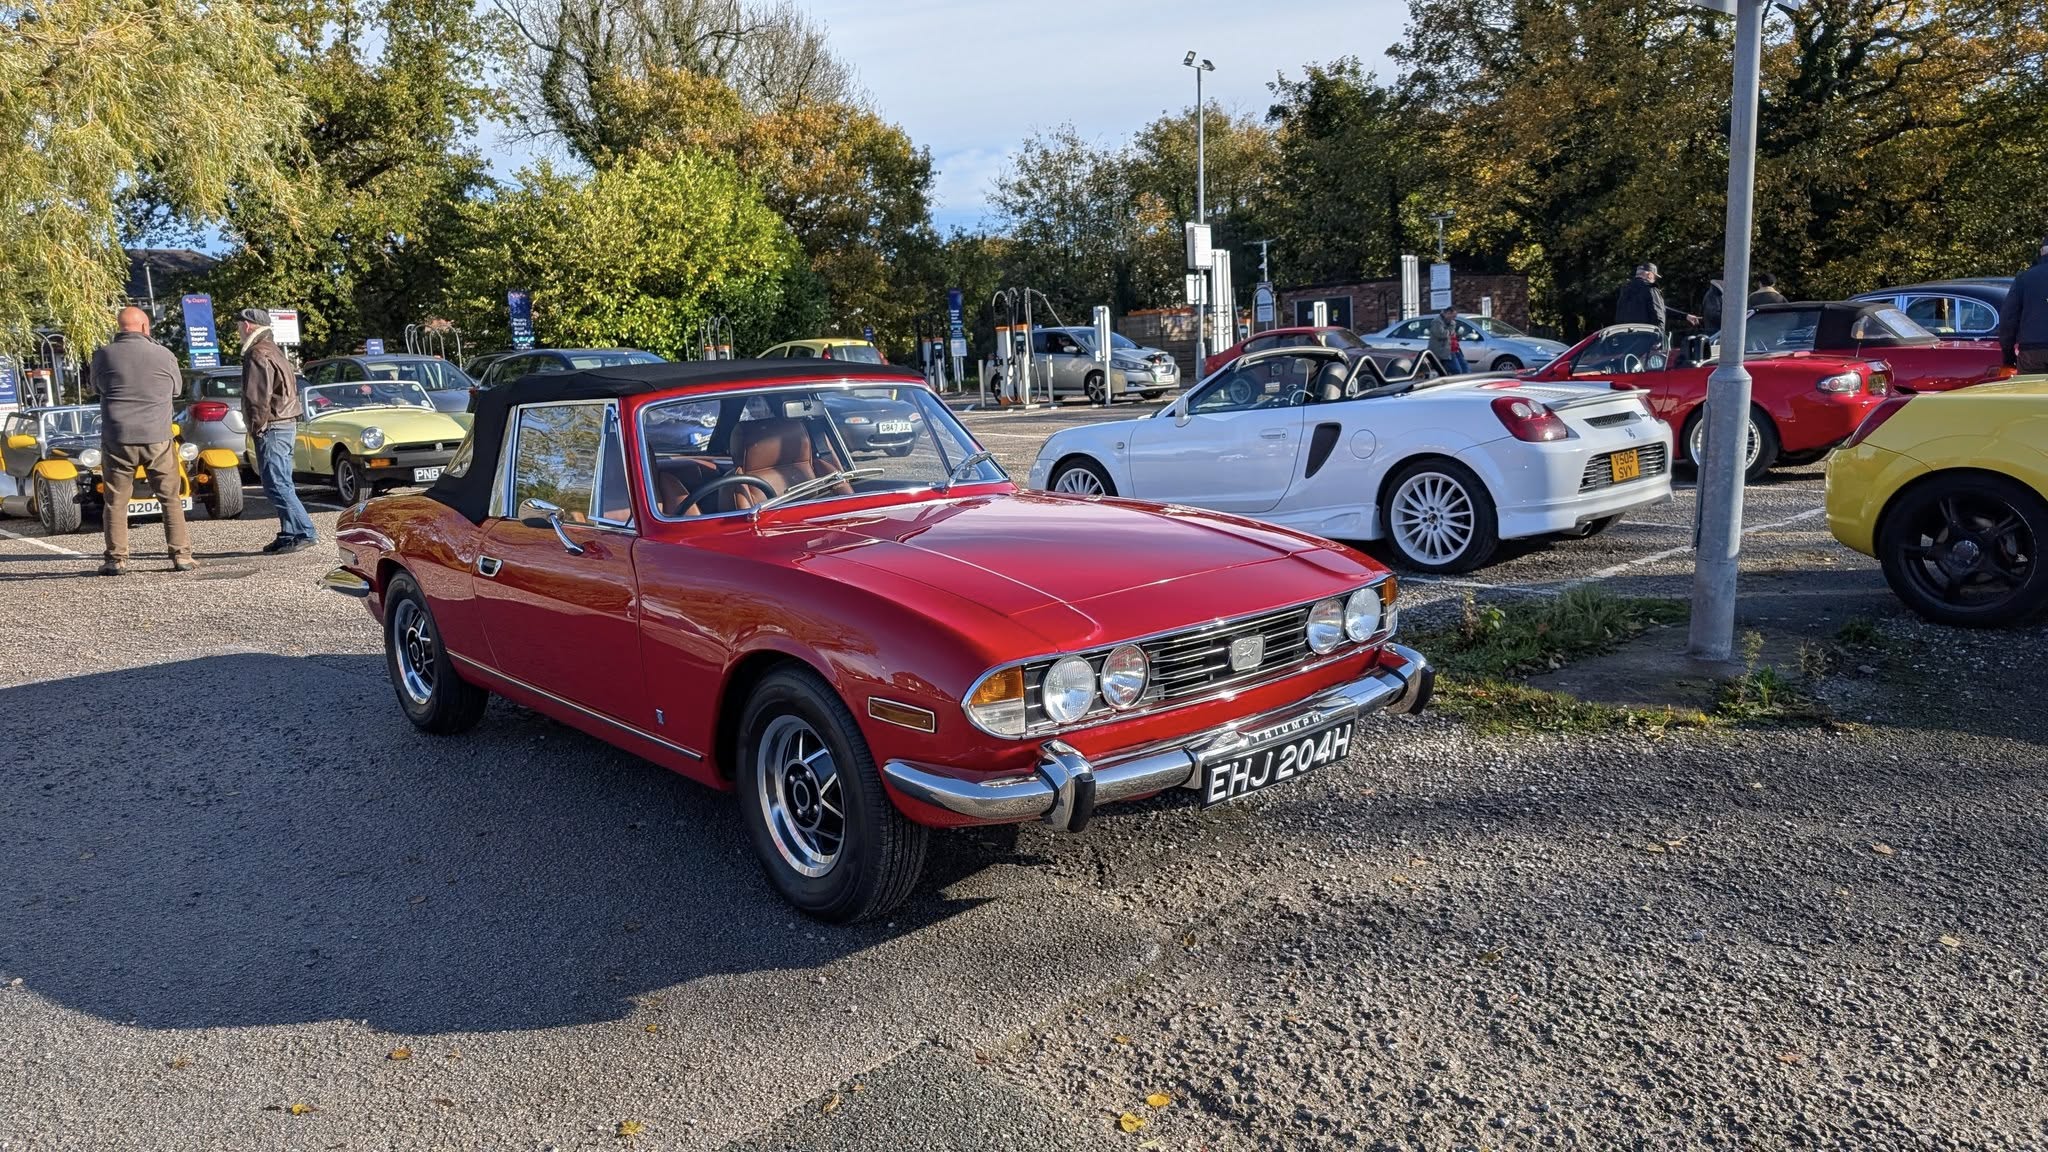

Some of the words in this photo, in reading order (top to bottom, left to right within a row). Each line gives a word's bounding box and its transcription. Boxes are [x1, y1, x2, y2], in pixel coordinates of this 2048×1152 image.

[1253, 714, 1321, 742] TRIUMPH
[1206, 751, 1274, 804] EHJ
[1275, 723, 1352, 781] 204H
